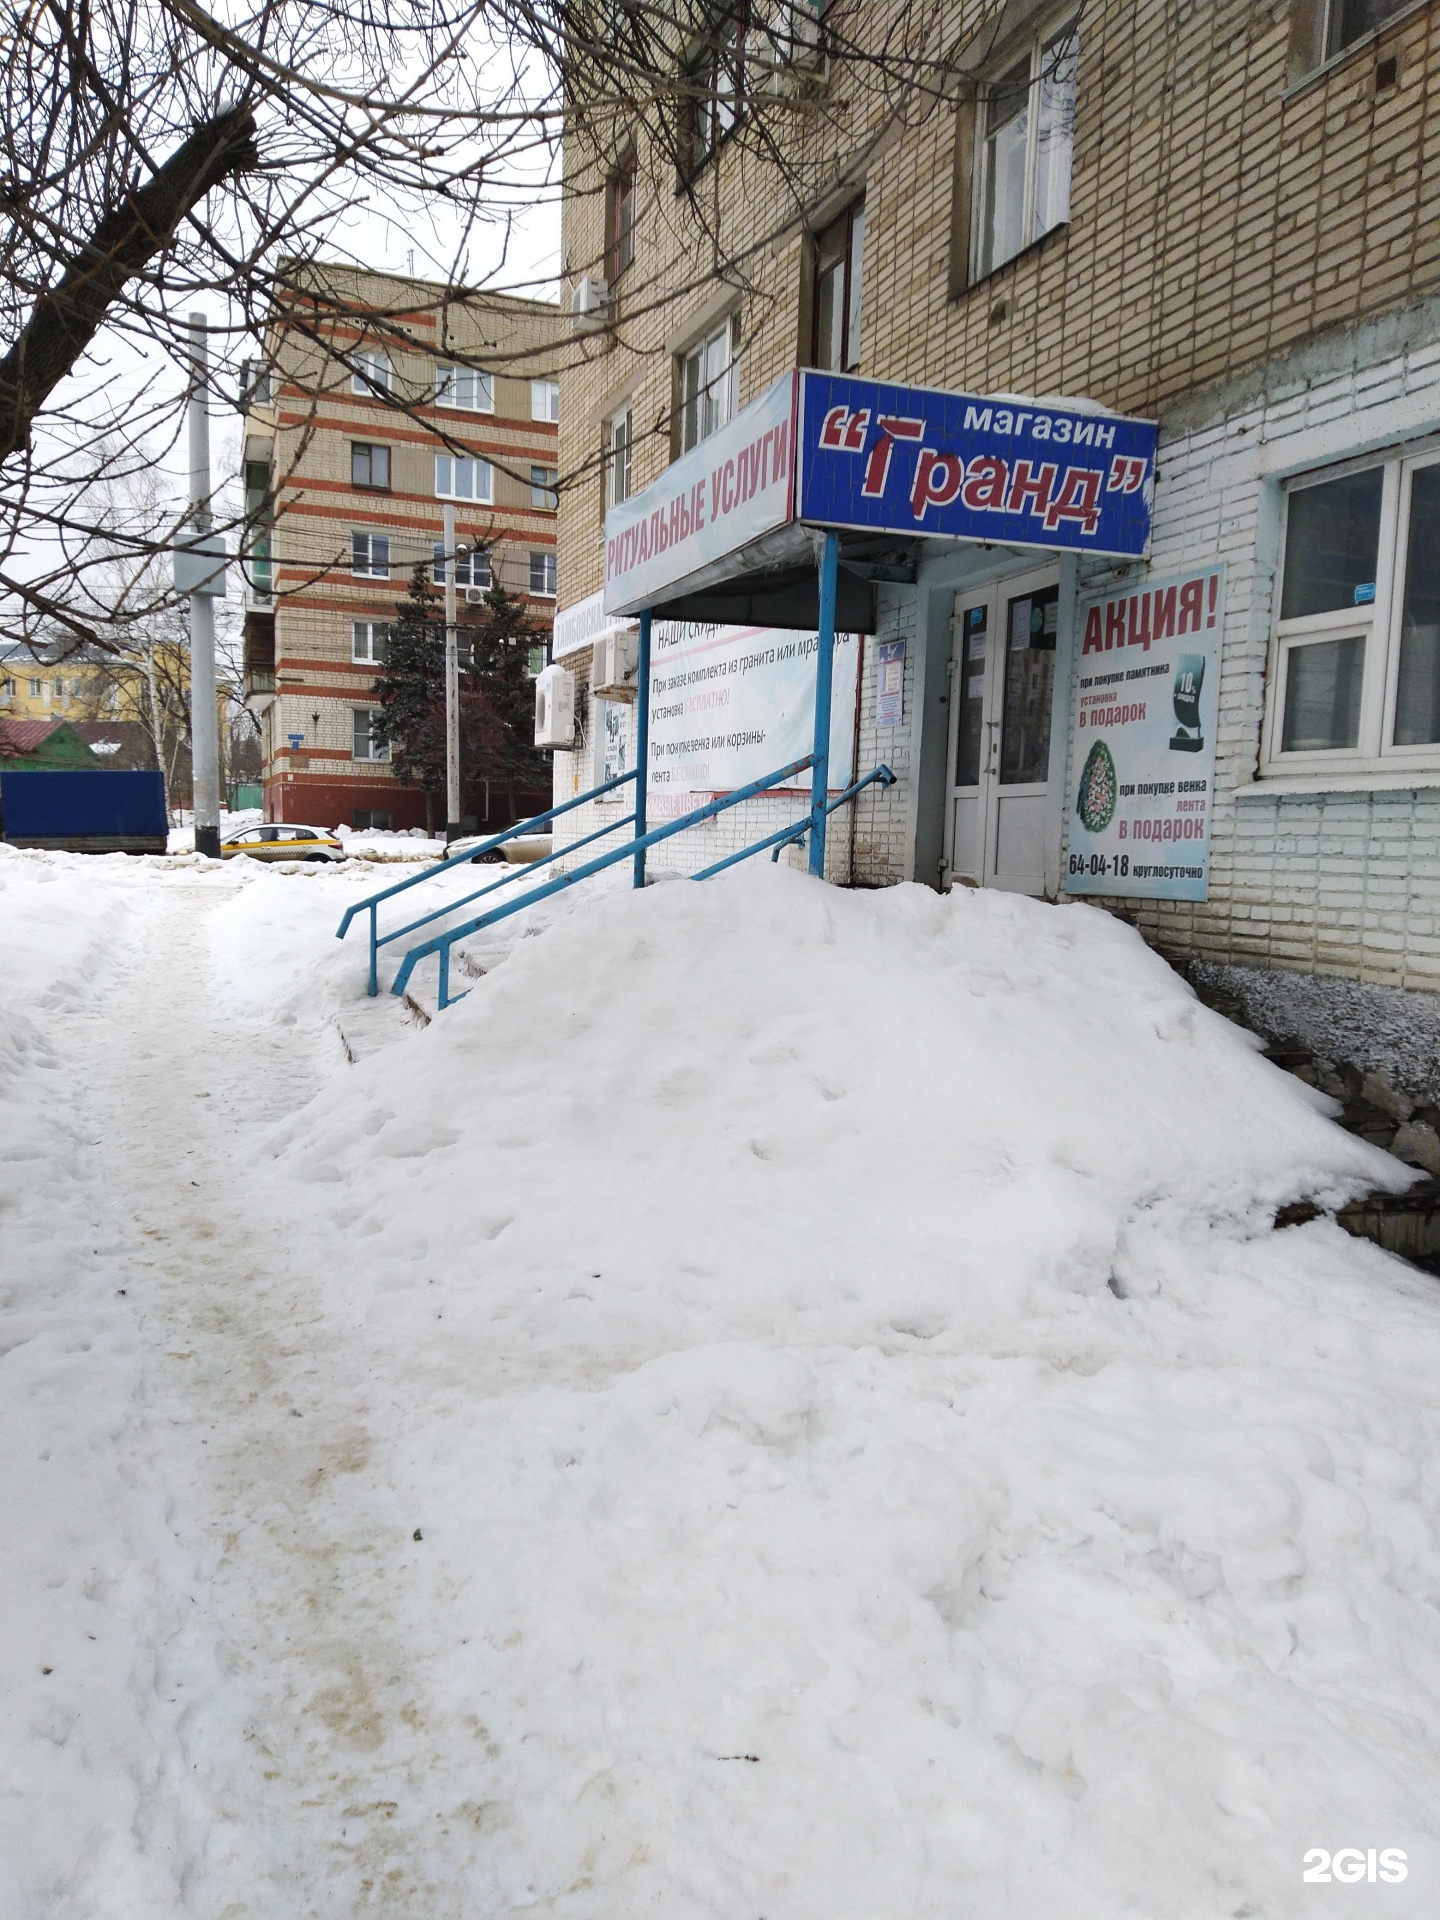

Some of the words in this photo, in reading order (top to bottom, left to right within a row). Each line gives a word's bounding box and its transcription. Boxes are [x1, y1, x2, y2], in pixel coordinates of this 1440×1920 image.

[963, 406, 1116, 449] магазин
[607, 478, 706, 582] РИТУАЛЬНЫЕ
[710, 418, 789, 524] УСЛУГИ
[1082, 574, 1219, 656] АКЦИЯ!
[658, 620, 686, 651] НАШИ
[688, 622, 726, 640] СКИД
[652, 678, 667, 698] При
[667, 675, 687, 691] заказе
[687, 663, 727, 686] комплекта
[728, 663, 738, 673] из
[739, 650, 775, 676] гранита
[777, 643, 796, 660] или
[798, 632, 850, 660] мрара
[1080, 676, 1093, 690] при
[1094, 671, 1125, 686] покупке
[1125, 663, 1170, 681] памятника
[651, 701, 684, 724] установка
[1080, 691, 1118, 708] установка
[1079, 711, 1087, 728] в
[1090, 702, 1147, 728] подарок
[651, 742, 665, 761] При
[666, 741, 690, 758] покупке
[690, 737, 710, 752] венка
[711, 734, 725, 749] или
[651, 770, 671, 784] лента
[1120, 784, 1135, 797] при
[1137, 781, 1175, 796] покупке
[1178, 780, 1207, 793] венка
[1176, 799, 1206, 812] лента
[1119, 820, 1128, 839] в
[1133, 818, 1205, 843] подарок
[1069, 853, 1129, 877] 64-04-18
[1133, 865, 1203, 879] круглосуточно
